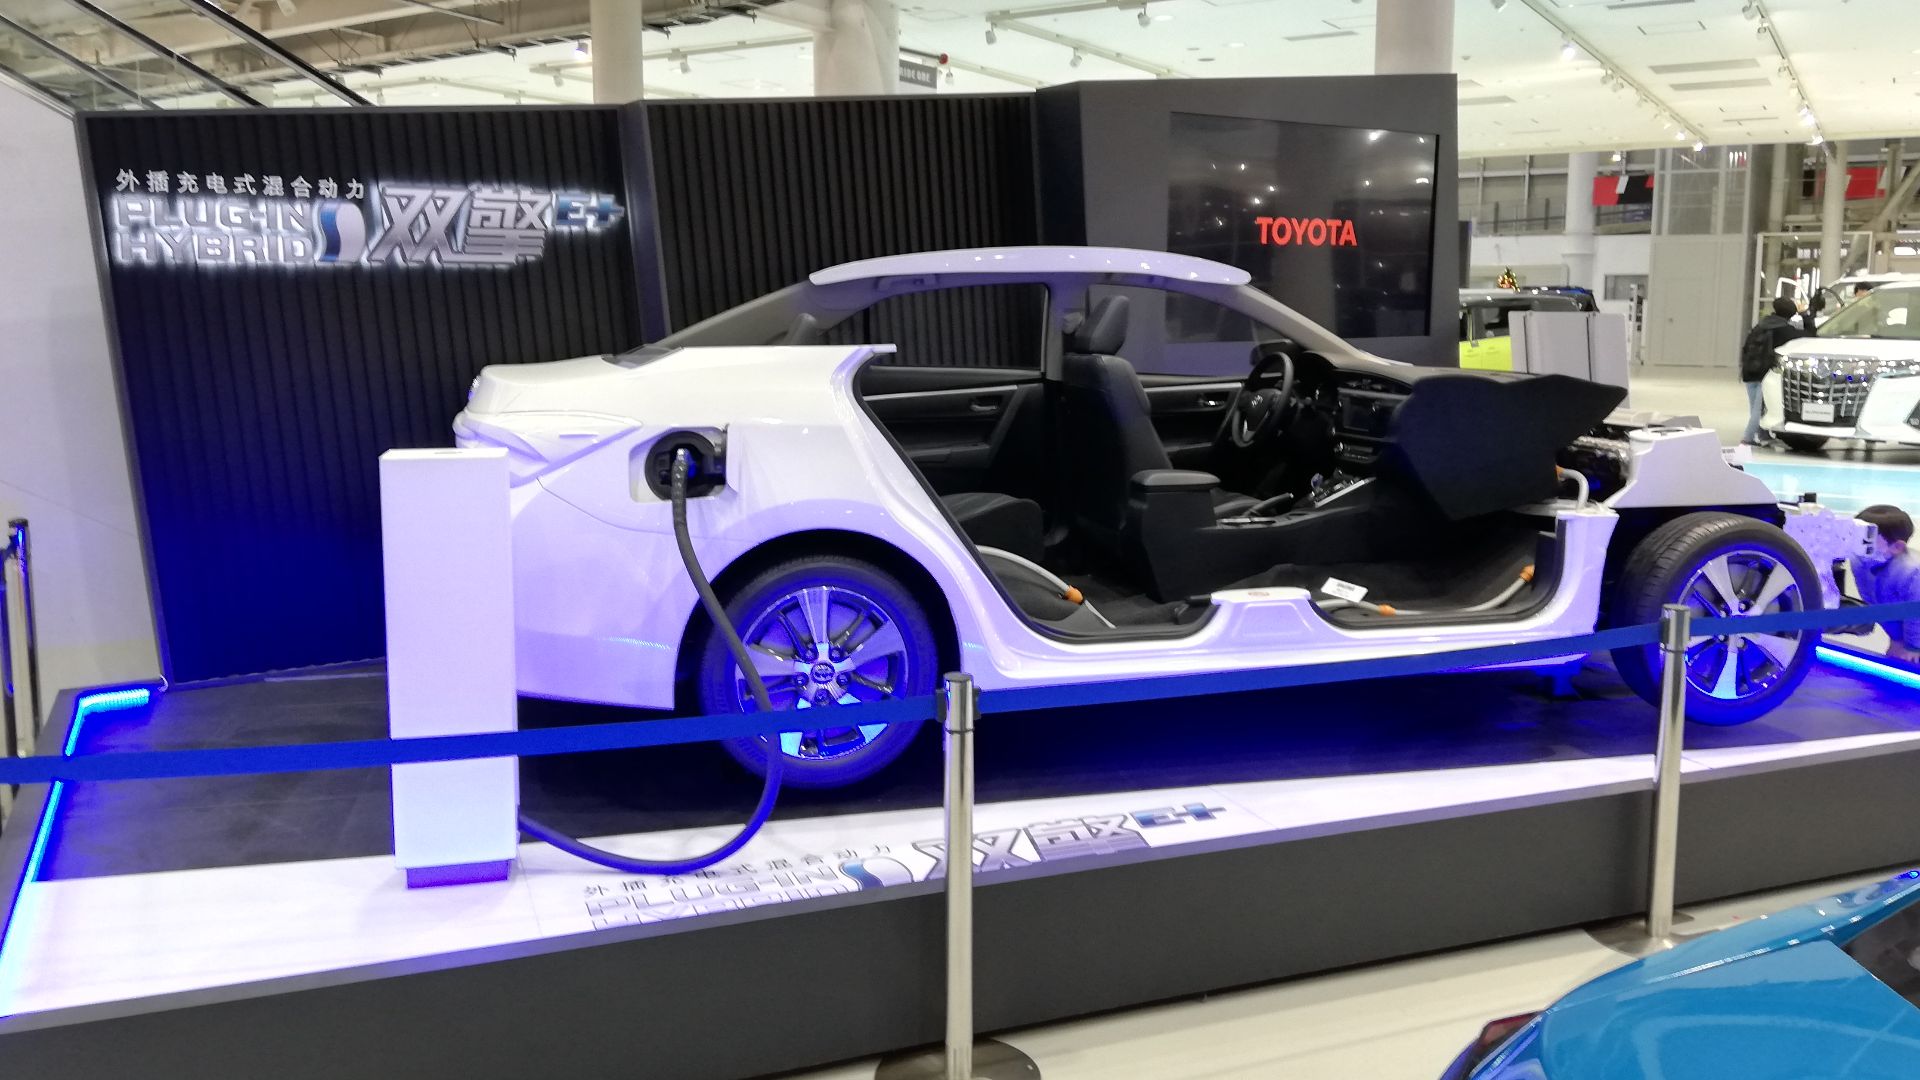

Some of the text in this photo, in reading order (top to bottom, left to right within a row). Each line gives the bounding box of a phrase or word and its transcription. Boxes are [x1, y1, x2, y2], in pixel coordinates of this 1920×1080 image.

[116, 168, 365, 199] 外插充电式混合动力
[1255, 216, 1358, 247] TOYOTA
[119, 231, 314, 264] HYBRID
